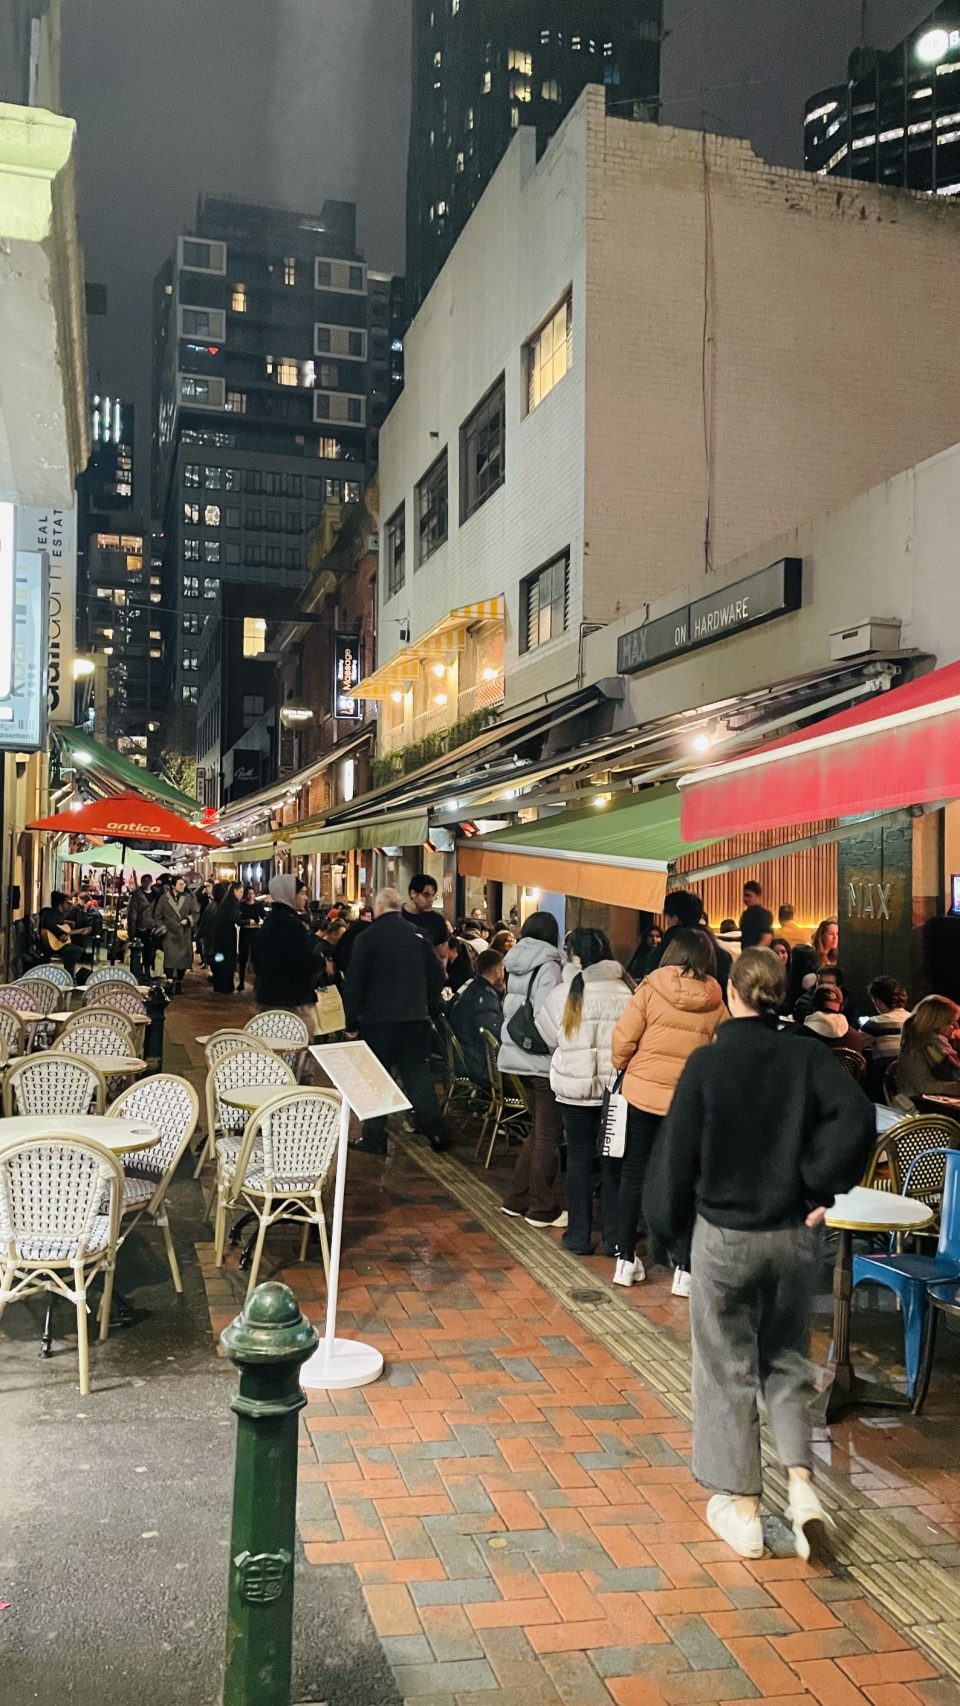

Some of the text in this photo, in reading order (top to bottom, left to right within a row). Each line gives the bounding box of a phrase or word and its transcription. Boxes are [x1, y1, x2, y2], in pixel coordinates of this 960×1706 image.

[52, 510, 63, 557] ESTAT
[674, 624, 687, 646] ON
[694, 597, 749, 638] HARDWARE
[343, 648, 353, 691] Massage
[0, 732, 35, 740] asement
[106, 822, 161, 833] antico
